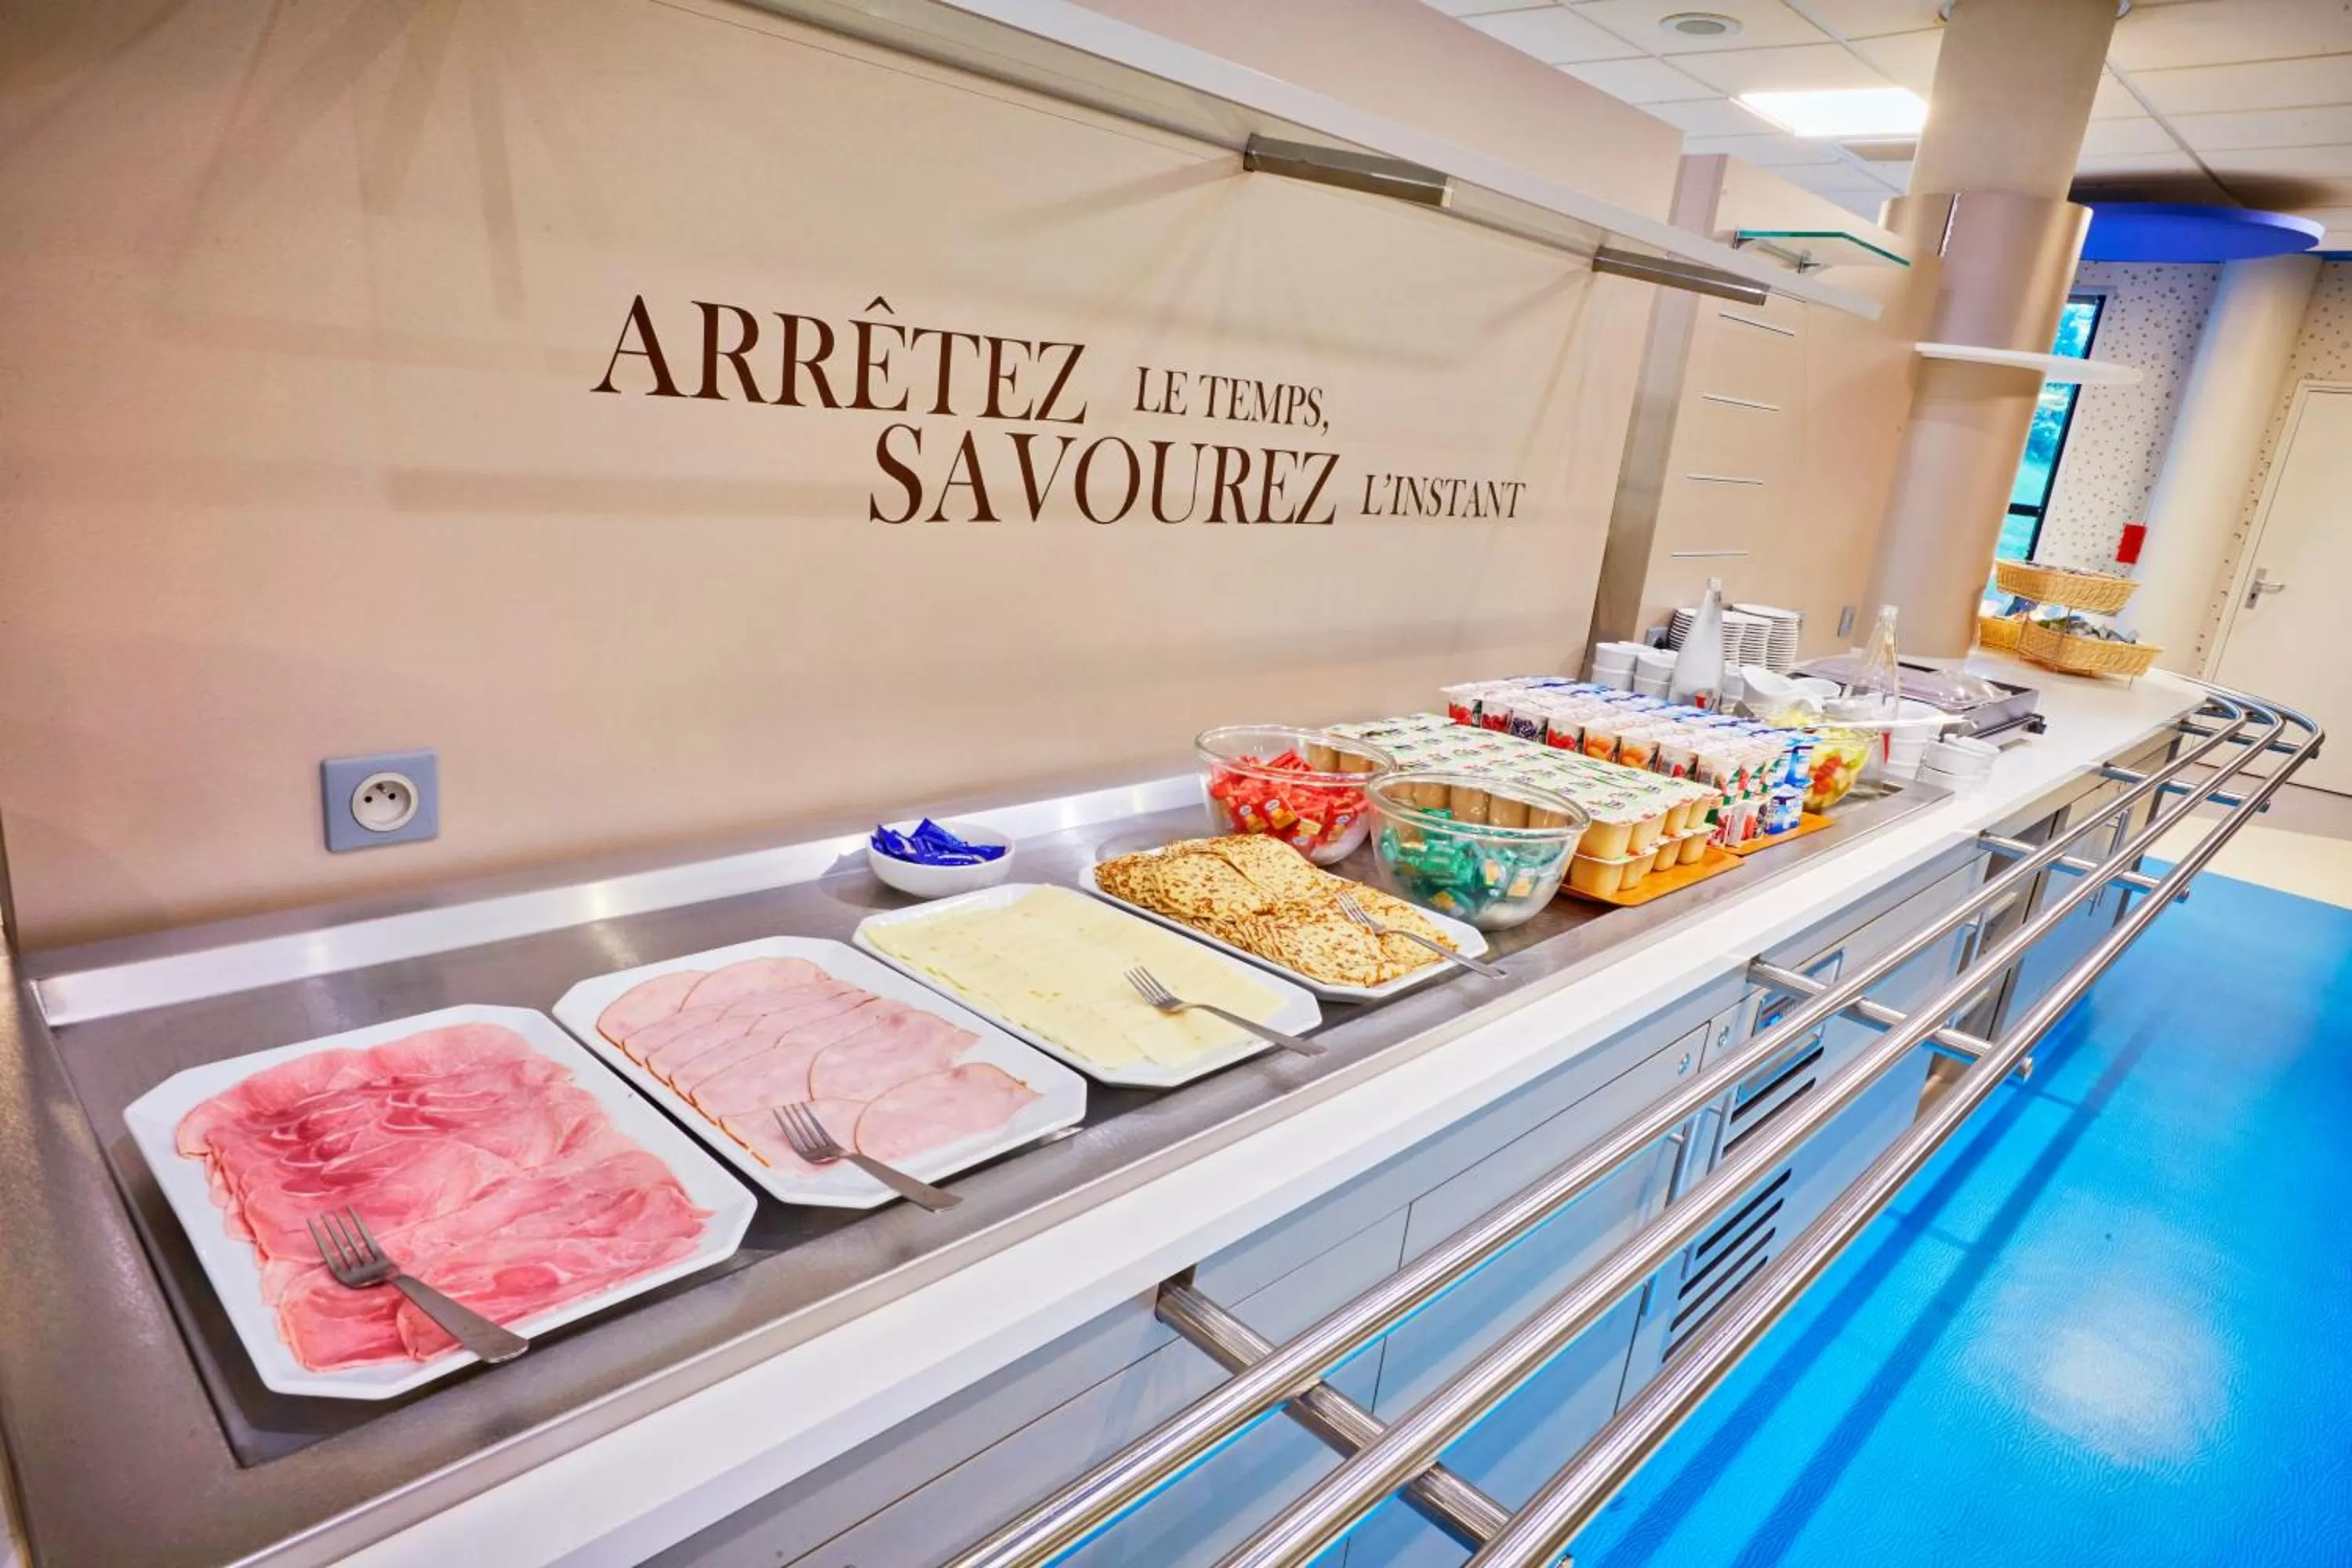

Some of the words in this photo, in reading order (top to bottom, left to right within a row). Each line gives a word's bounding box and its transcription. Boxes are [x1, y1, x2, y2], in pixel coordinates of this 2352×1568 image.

[590, 294, 1087, 424] ARRÊTEZ
[1134, 366, 1188, 416] LE
[1199, 374, 1330, 436] TEMPS,
[869, 423, 1340, 525] SAVOUREZ
[1360, 473, 1526, 519] L'INSTANT
